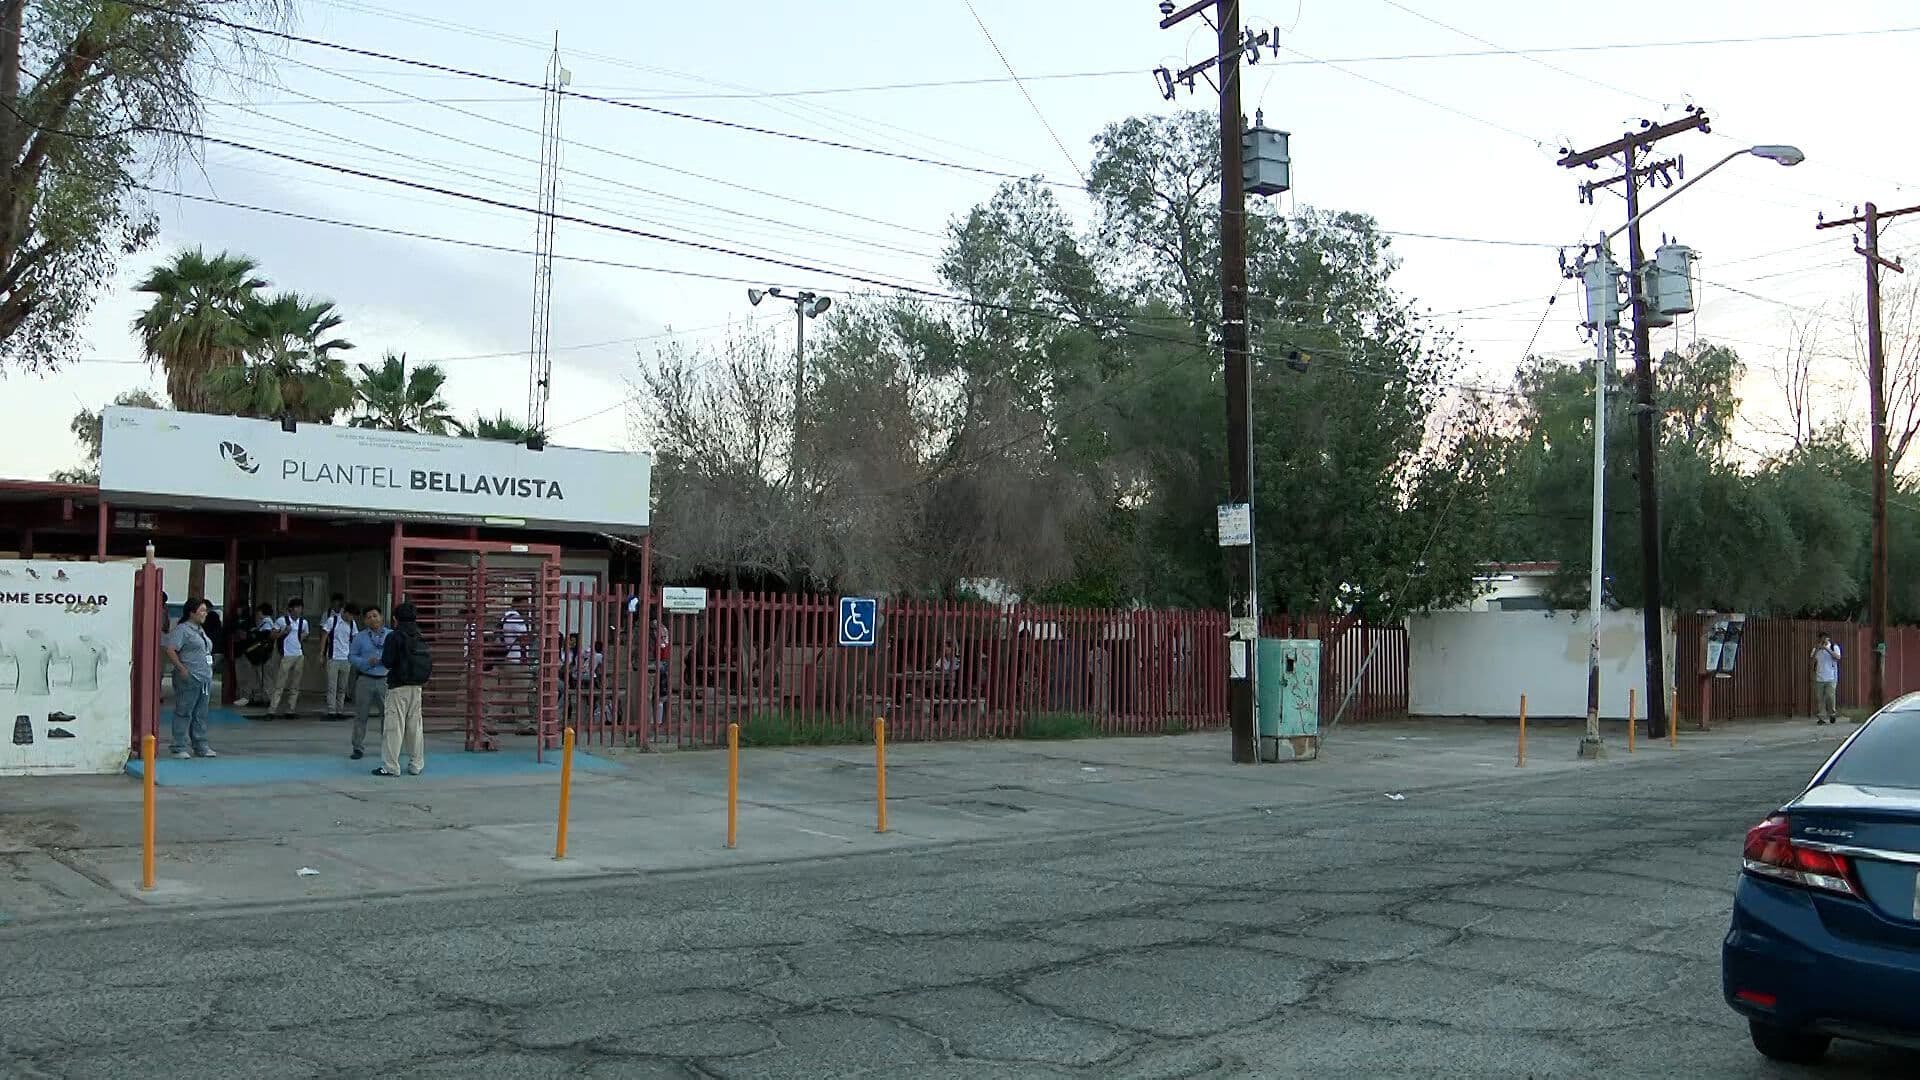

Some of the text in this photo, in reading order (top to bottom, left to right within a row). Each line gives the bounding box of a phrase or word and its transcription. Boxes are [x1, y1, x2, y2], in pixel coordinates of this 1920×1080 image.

[283, 459, 564, 500] PLANTEL BELLAVISTA
[35, 593, 108, 606] ESCOLAR
